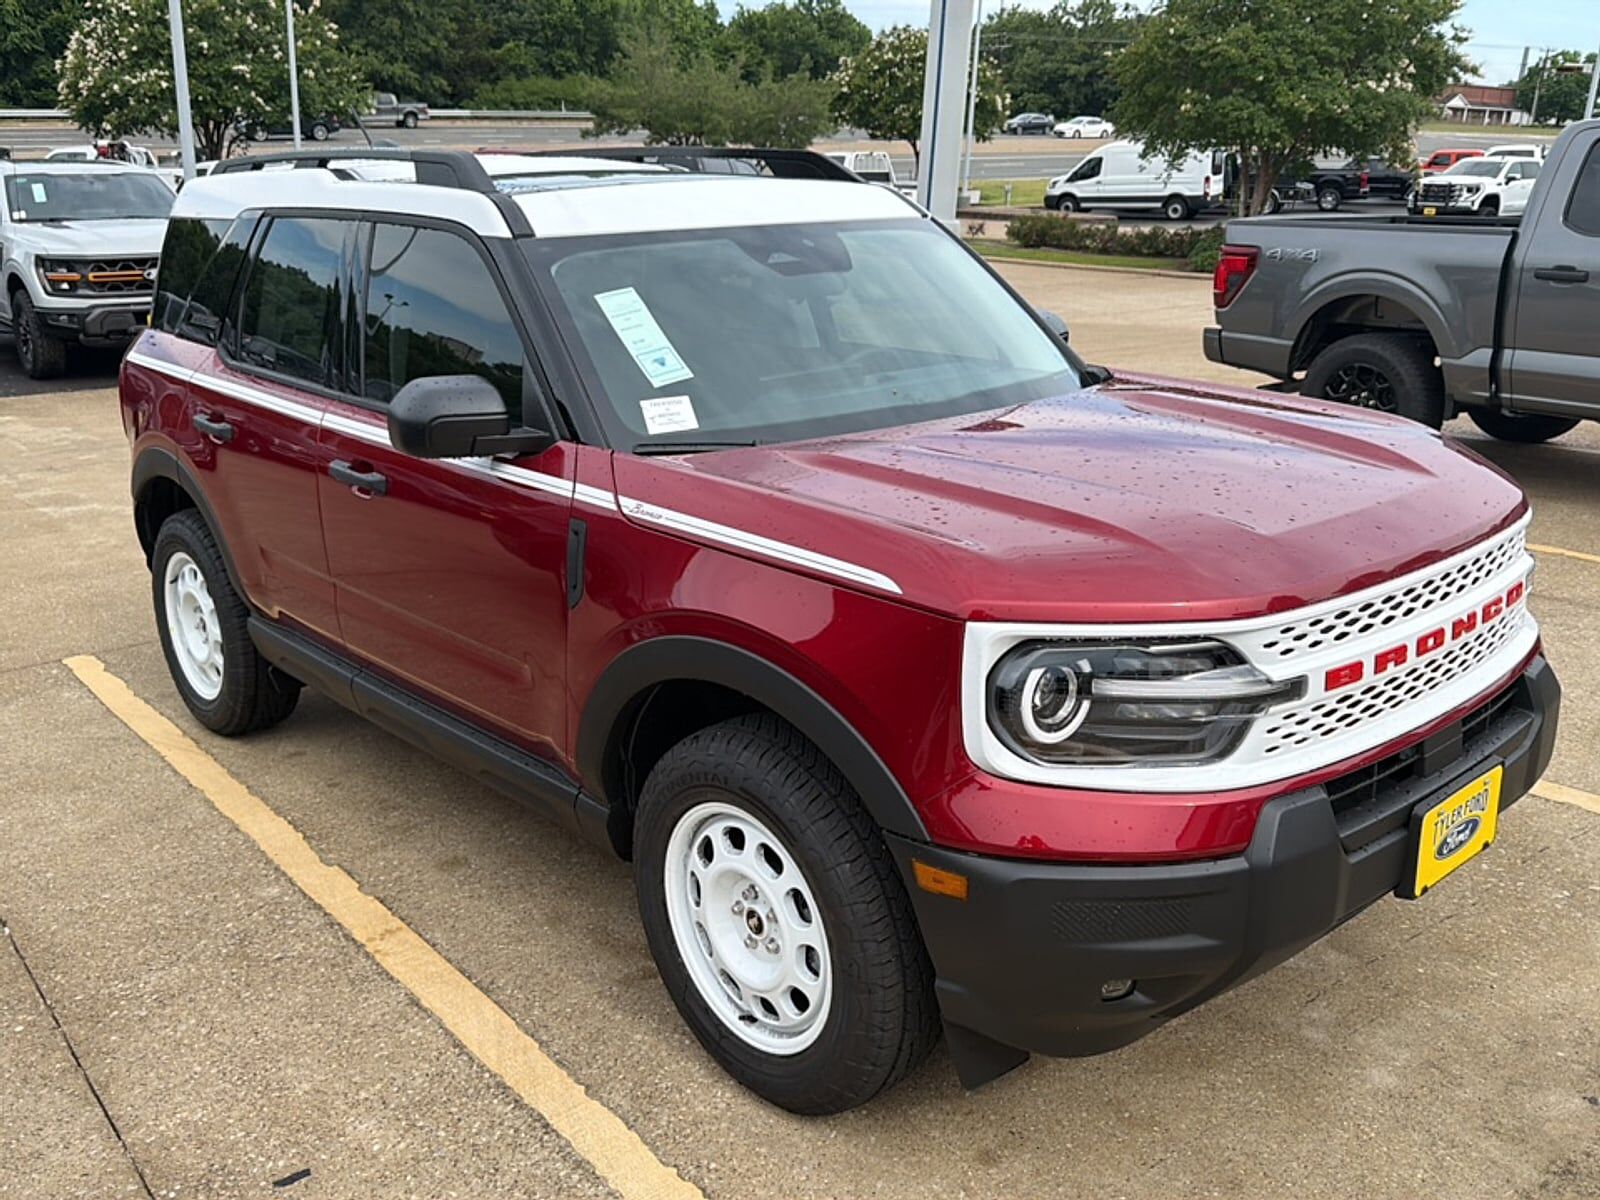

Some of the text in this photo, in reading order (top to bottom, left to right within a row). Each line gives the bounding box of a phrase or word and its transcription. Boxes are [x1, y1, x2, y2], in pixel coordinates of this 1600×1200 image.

[1325, 581, 1524, 692] BRONCO
[1434, 786, 1490, 847] TYLER FORD
[1442, 822, 1474, 854] Ford
